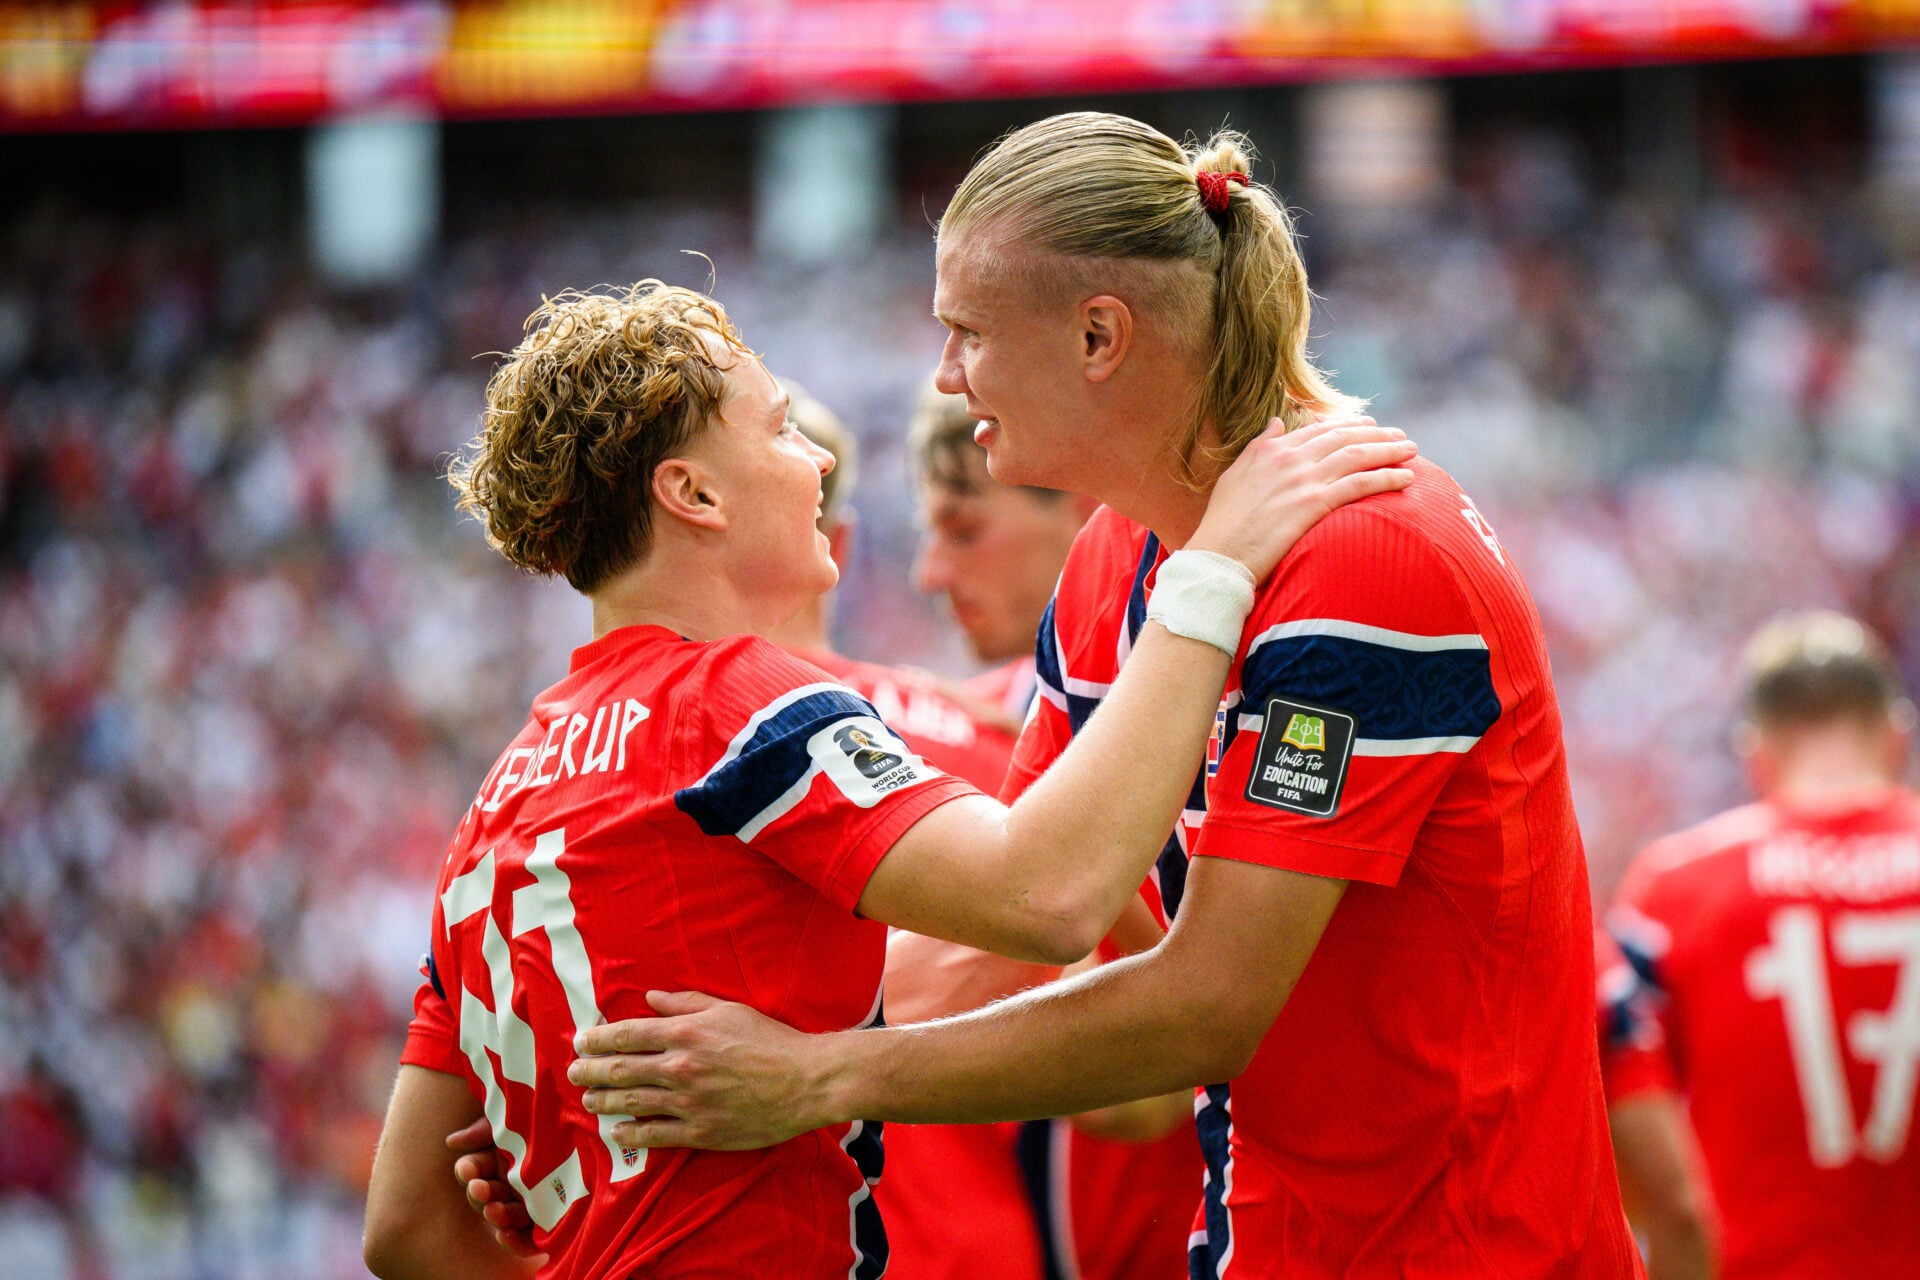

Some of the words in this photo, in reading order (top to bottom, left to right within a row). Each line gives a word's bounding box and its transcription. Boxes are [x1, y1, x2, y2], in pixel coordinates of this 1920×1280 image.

[872, 758, 894, 771] FIFA
[1275, 746, 1304, 768] Unite
[1305, 754, 1325, 772] For
[871, 771, 898, 789] WORLD
[897, 765, 911, 774] CUP
[1262, 765, 1328, 795] EDUCATION
[441, 827, 649, 1232] 21
[1742, 902, 1920, 1169] 17
